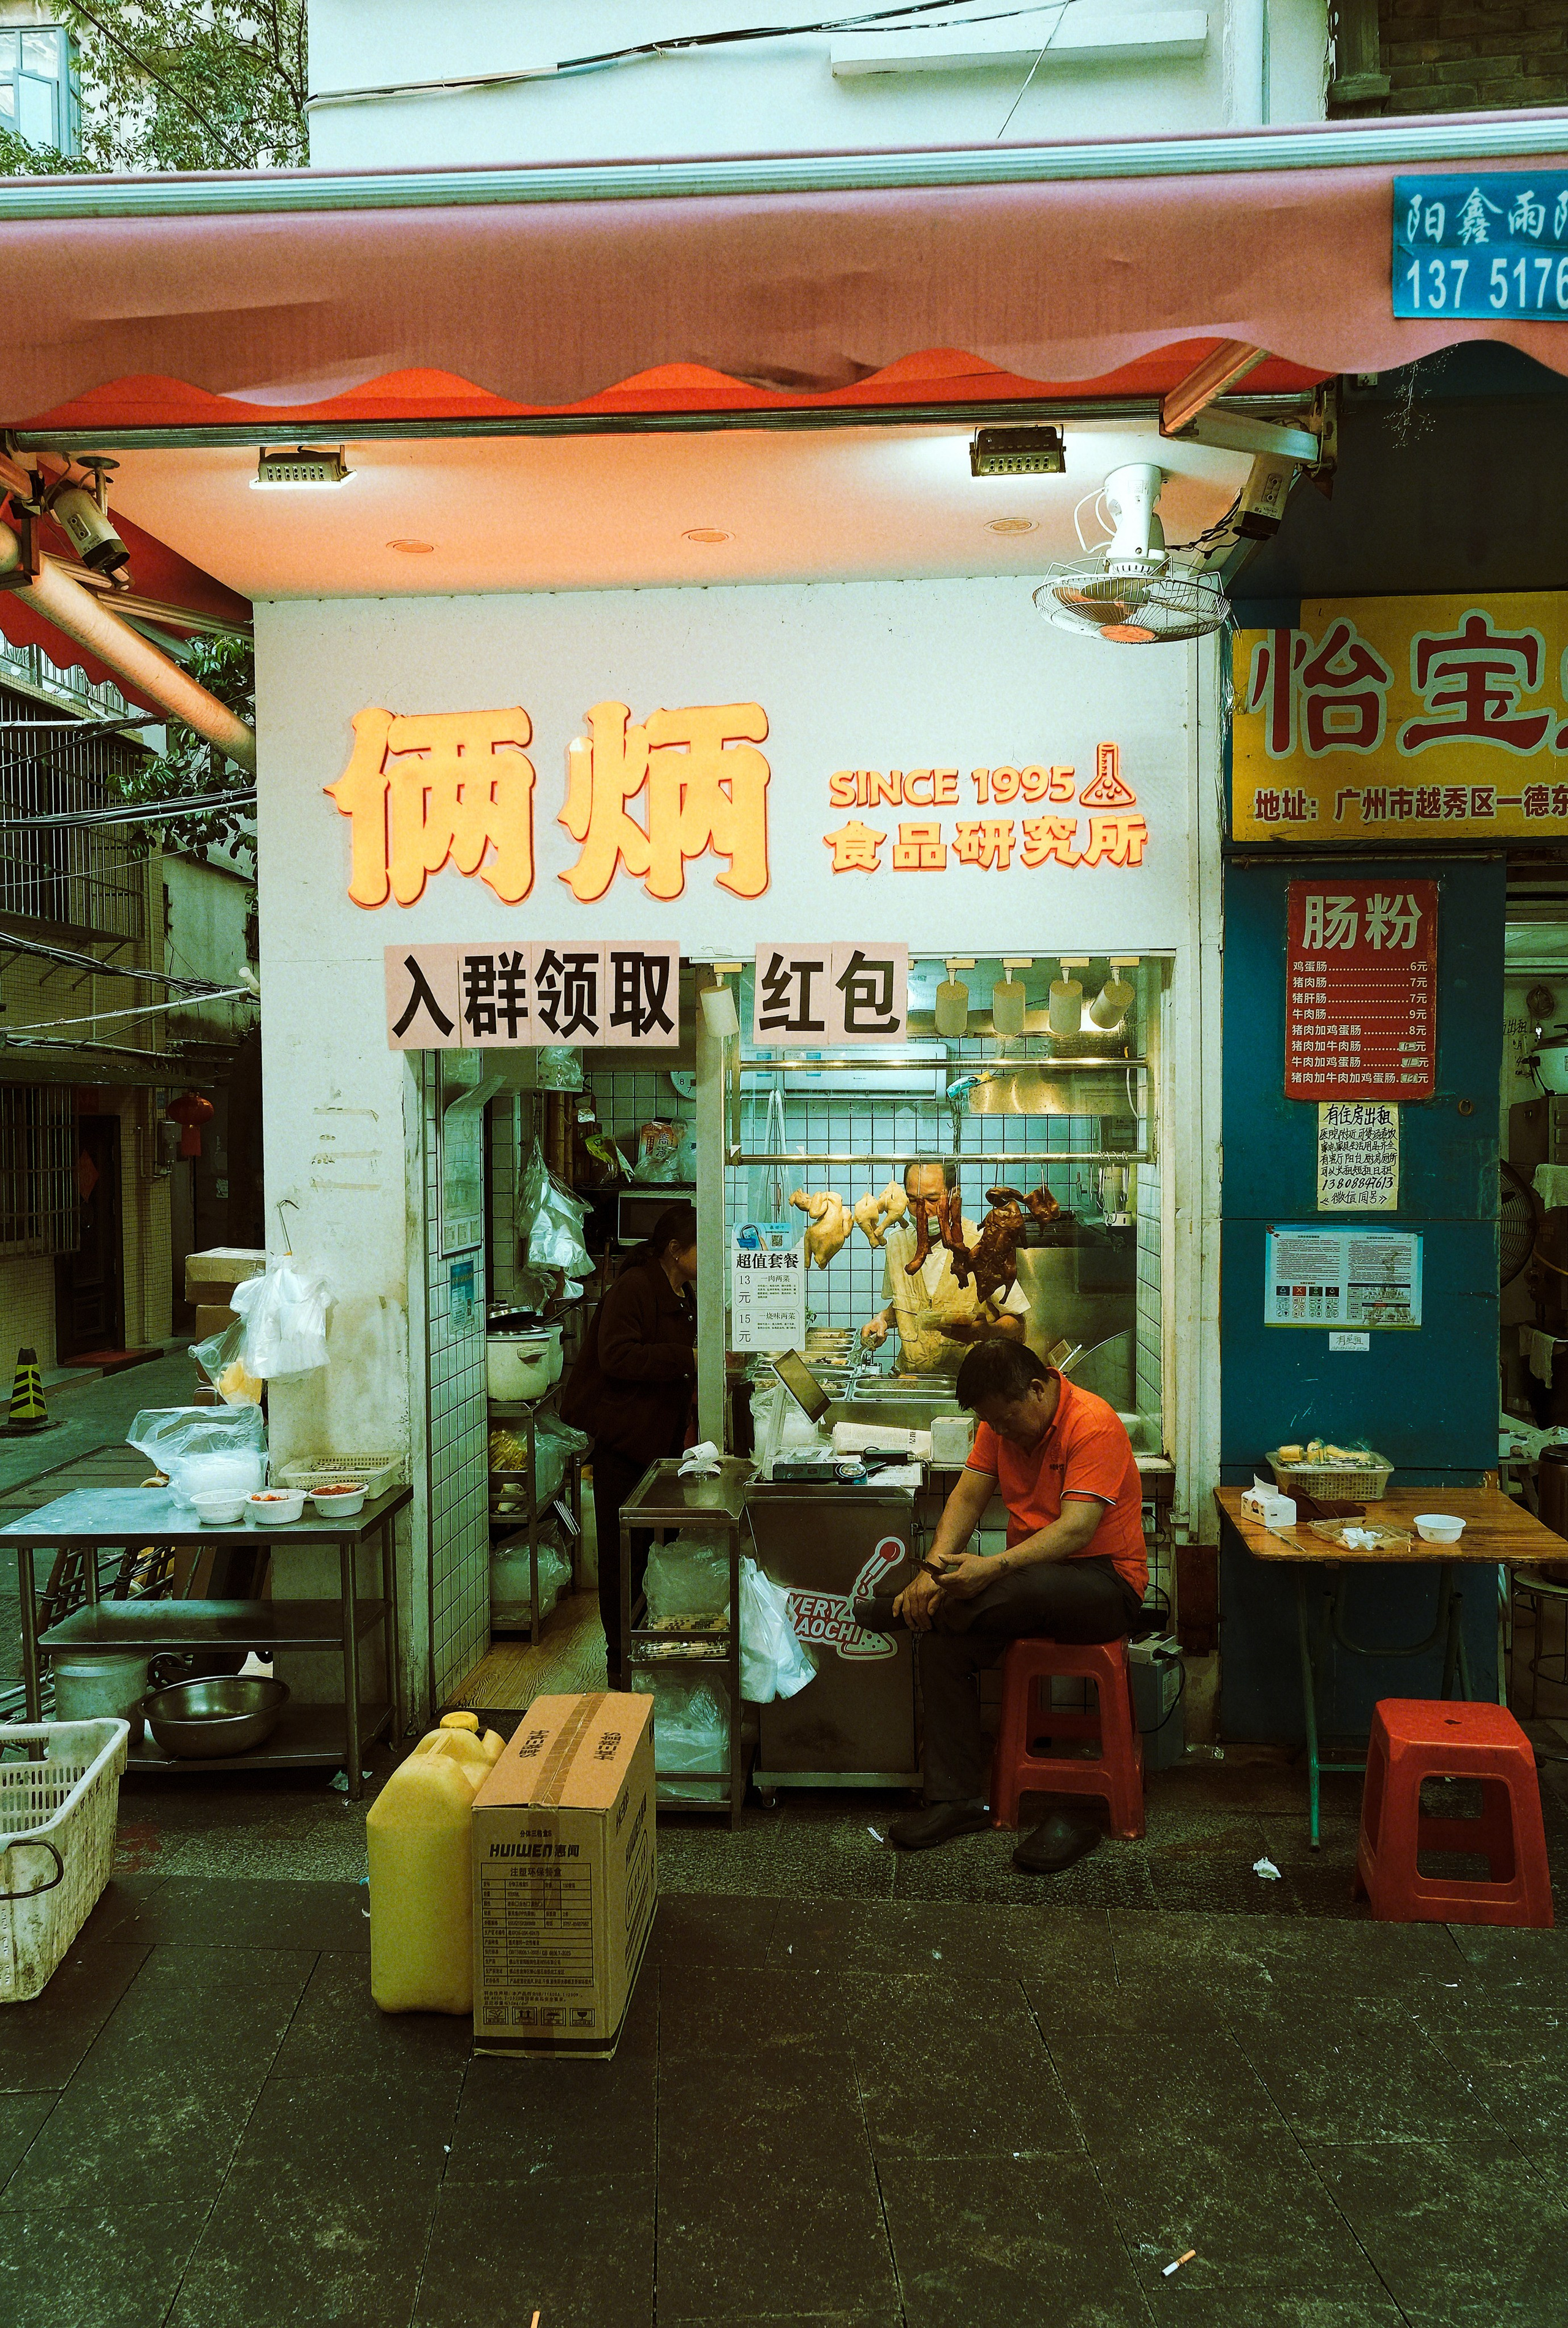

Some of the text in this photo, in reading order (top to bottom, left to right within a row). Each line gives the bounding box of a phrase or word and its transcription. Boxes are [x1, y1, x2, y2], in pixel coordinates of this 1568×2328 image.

[1407, 257, 1568, 309] 137 5176
[1250, 610, 1568, 758] 怡宝
[829, 765, 1076, 808] SINCE 1995
[323, 701, 772, 908] 俩炳
[823, 815, 1148, 875] 食品研究所
[1302, 894, 1423, 949] 肠粉
[1293, 961, 1428, 971] 鸡蛋肠 6元
[1293, 977, 1428, 988] 猪肉肠 7元
[392, 949, 901, 1039] 入群领取 红包
[1292, 993, 1427, 1004] 猪肝肠 7元
[1292, 1009, 1427, 1020] 牛肉肠 9元
[1292, 1025, 1427, 1036] 猪肉加鸡蛋肠 8元
[1292, 1041, 1361, 1052] 猪肉加牛肉肠
[1291, 1057, 1361, 1068] 牛肉加鸡蛋肠
[1291, 1072, 1395, 1083] 猪肉加牛肉加鸡蛋肠
[1324, 1104, 1393, 1126] 有住房出租
[1322, 1176, 1393, 1191] 13808847613
[736, 1253, 799, 1268] 超值套餐
[740, 1275, 750, 1284] 13
[739, 1292, 750, 1303] 元
[740, 1314, 750, 1323] 15
[739, 1331, 750, 1342] 元
[790, 1595, 844, 1619] VERY
